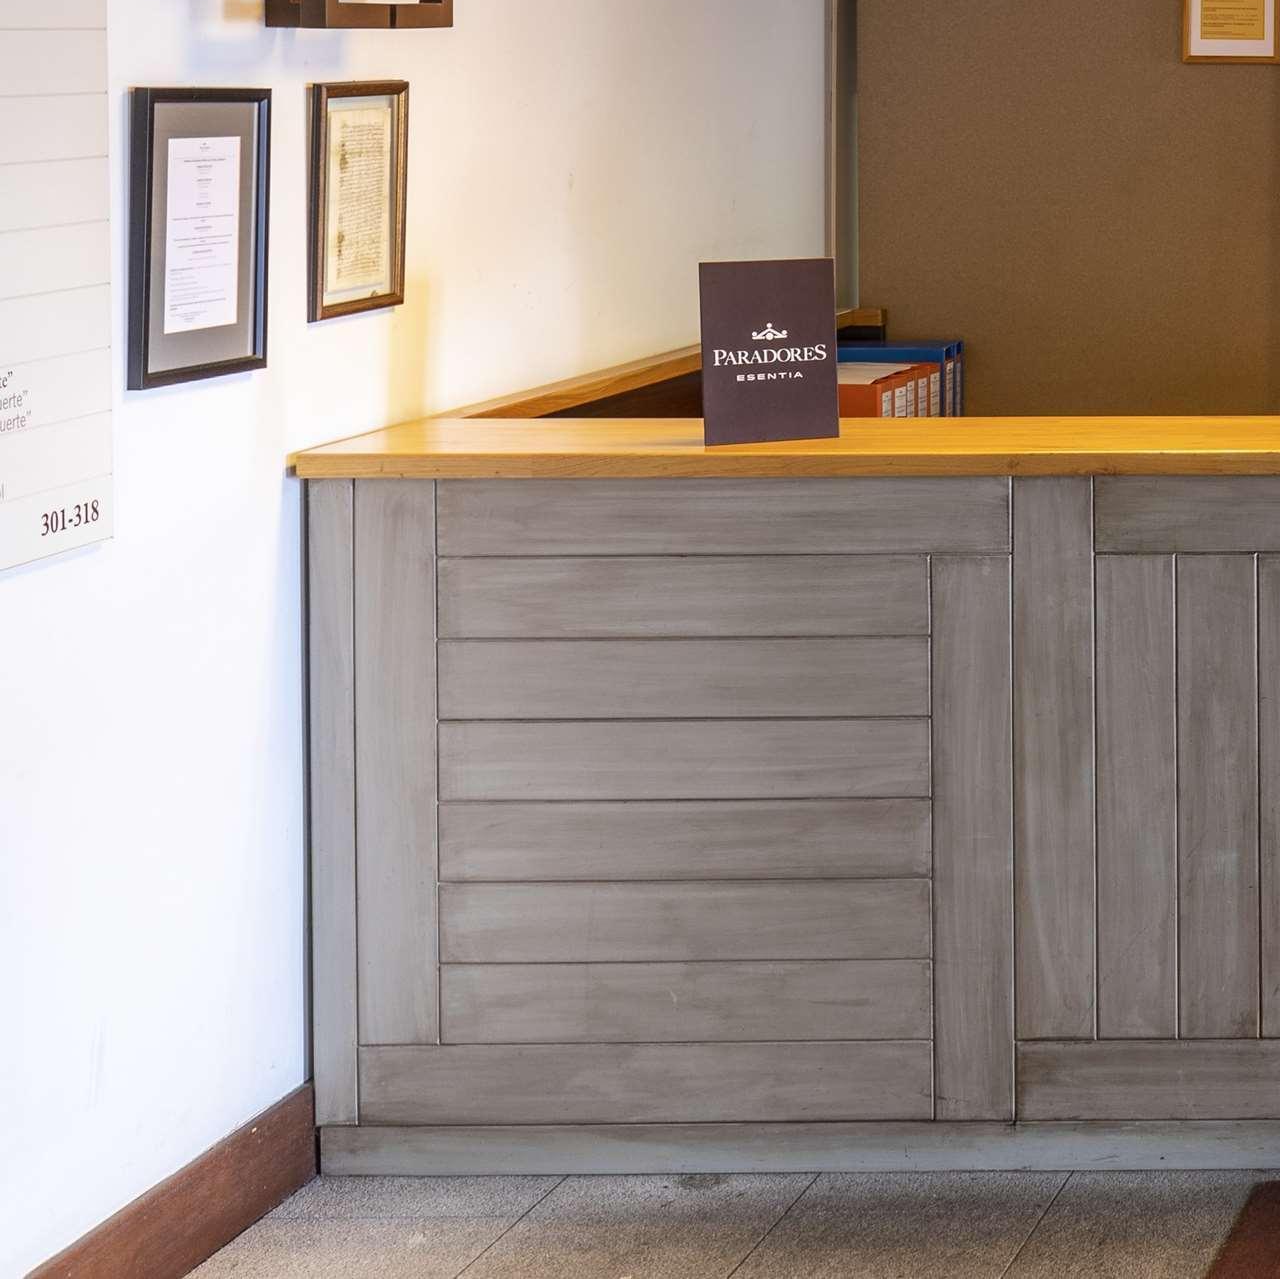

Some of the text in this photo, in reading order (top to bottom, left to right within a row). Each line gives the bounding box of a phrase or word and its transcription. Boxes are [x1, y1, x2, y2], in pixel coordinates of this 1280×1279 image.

[713, 344, 827, 367] PARADORES
[736, 371, 804, 382] ESENTIA
[41, 499, 99, 536] 301-318
